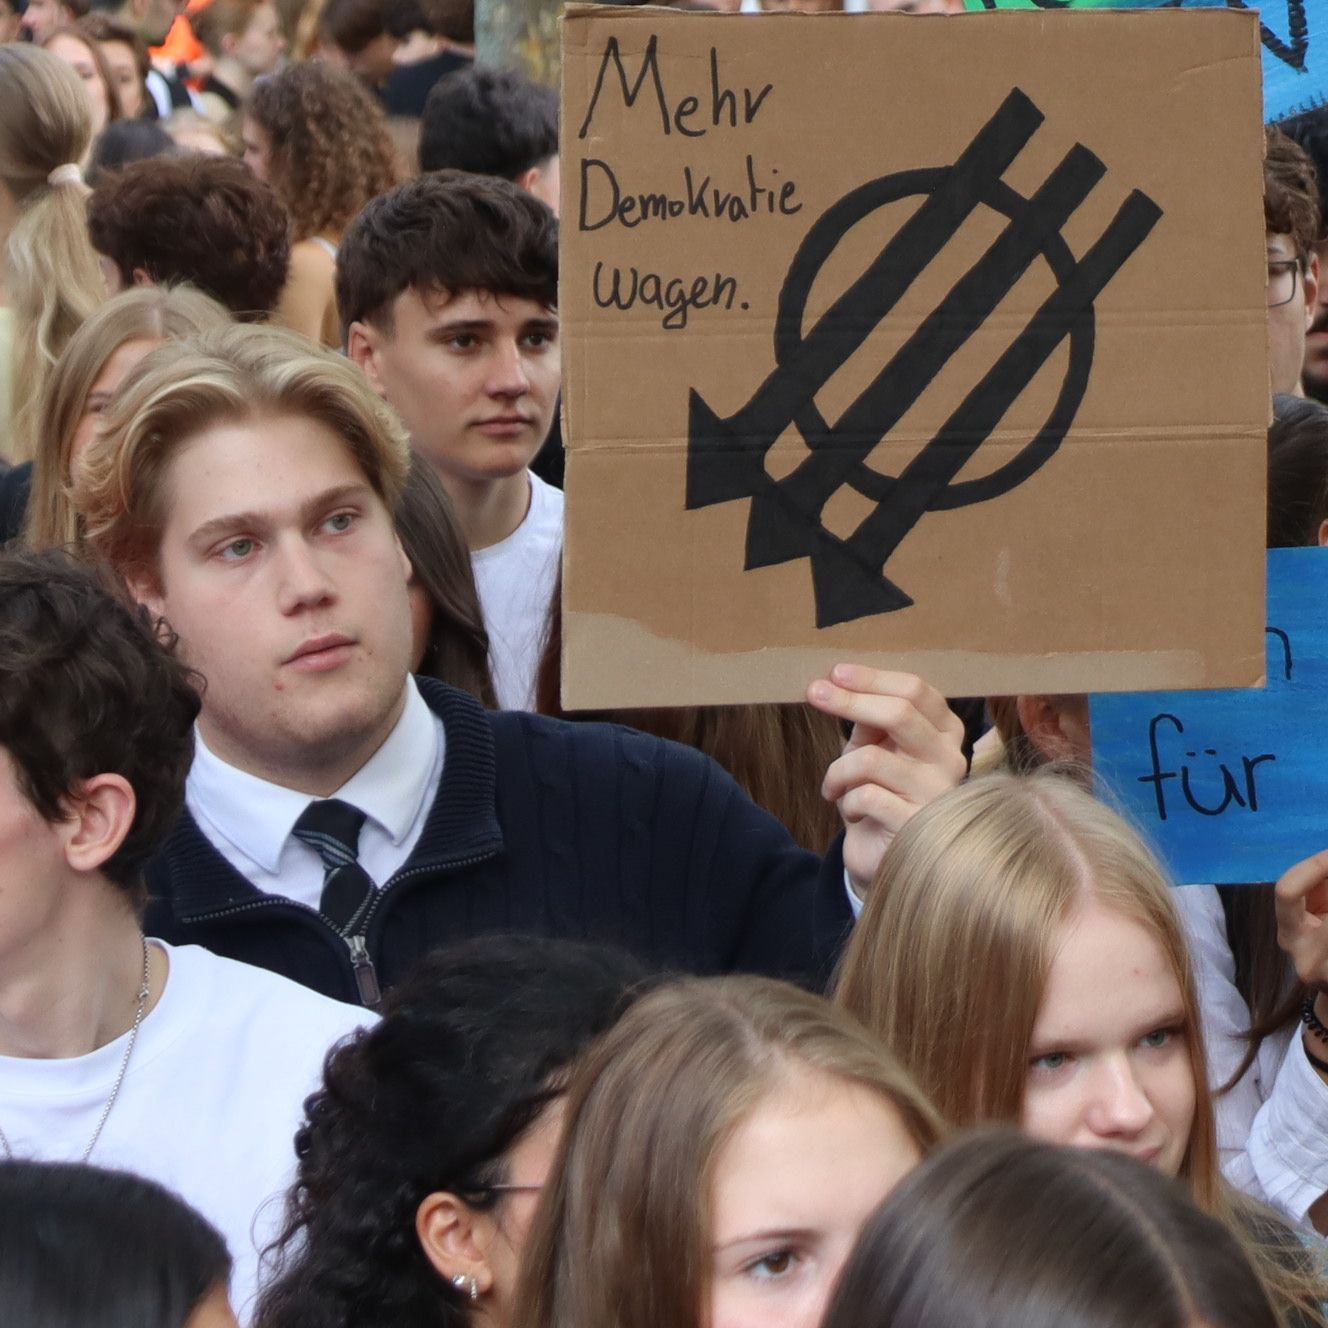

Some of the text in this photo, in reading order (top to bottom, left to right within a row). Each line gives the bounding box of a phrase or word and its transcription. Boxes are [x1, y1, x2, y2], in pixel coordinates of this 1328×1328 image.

[578, 33, 773, 140] Mehr
[578, 154, 803, 232] Demokratie
[1137, 712, 1277, 821] für
